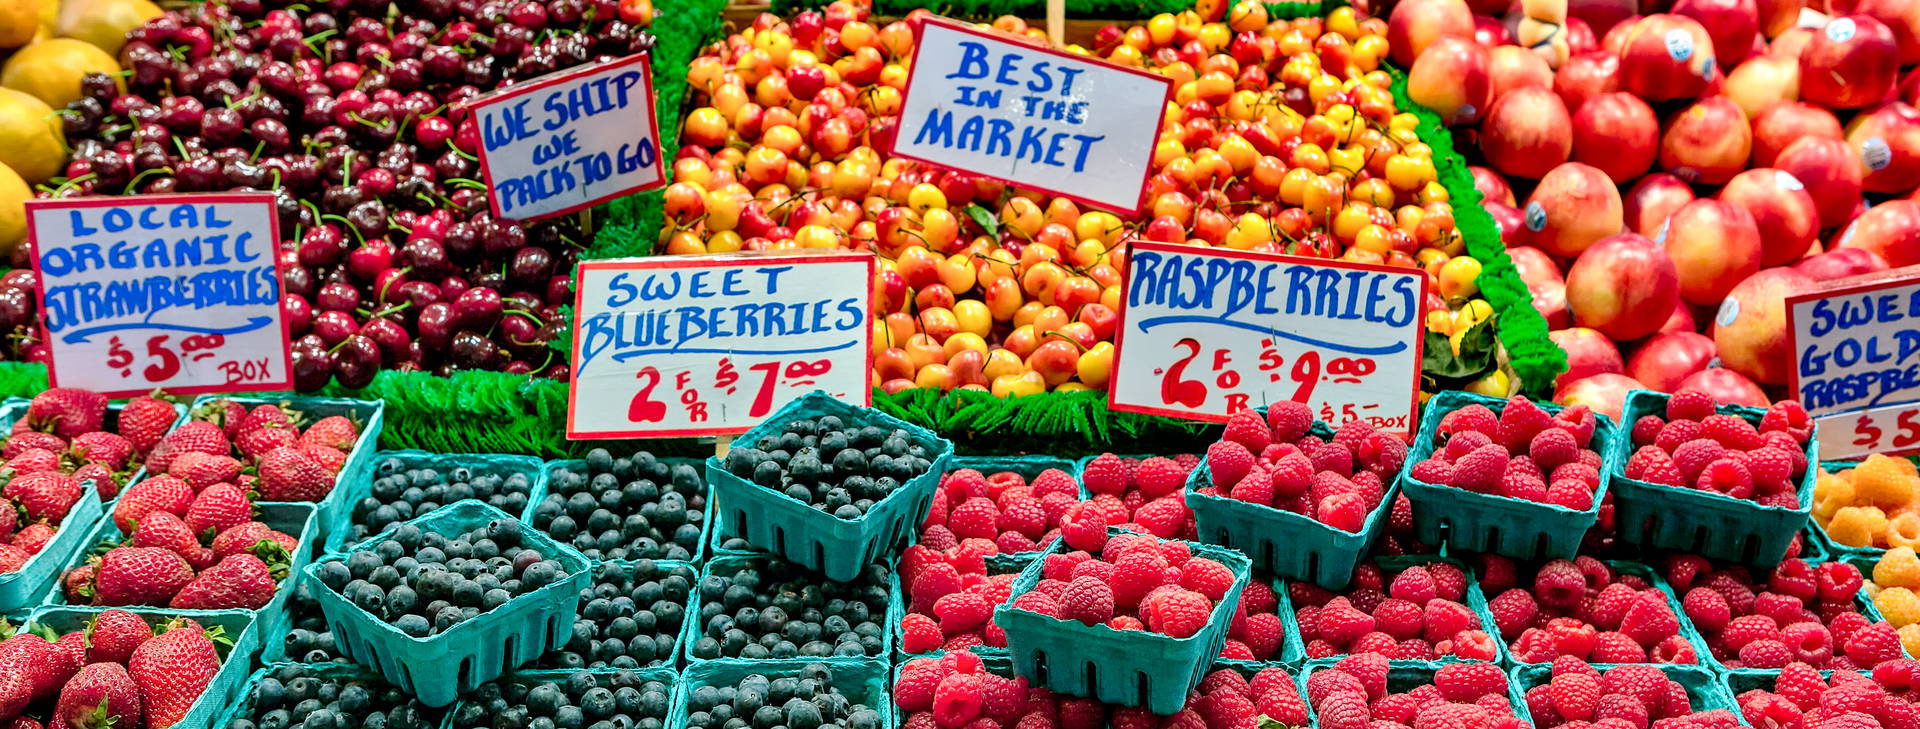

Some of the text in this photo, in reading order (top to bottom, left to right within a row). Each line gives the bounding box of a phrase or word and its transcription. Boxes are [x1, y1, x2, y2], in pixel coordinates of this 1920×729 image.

[945, 41, 1085, 97] BEST
[484, 70, 641, 152] WE SHIP
[953, 86, 1090, 125] IN THE
[532, 129, 581, 165] WE
[913, 107, 1106, 173] MARKET
[495, 136, 656, 212] PACK TO GO
[69, 204, 233, 237] LOCAL
[39, 231, 261, 277] ORGANIC
[44, 265, 280, 333] STRAWBERRIES
[607, 265, 793, 307] SWEET
[1128, 251, 1416, 328] RASPBERRIES
[576, 298, 864, 377] BLUEBERRIES
[217, 356, 272, 384] BOX
[627, 366, 667, 423] 2
[674, 370, 709, 423] FOR
[1161, 337, 1208, 408] 2
[1211, 349, 1252, 415] FOR
[1365, 414, 1407, 428] BOX
